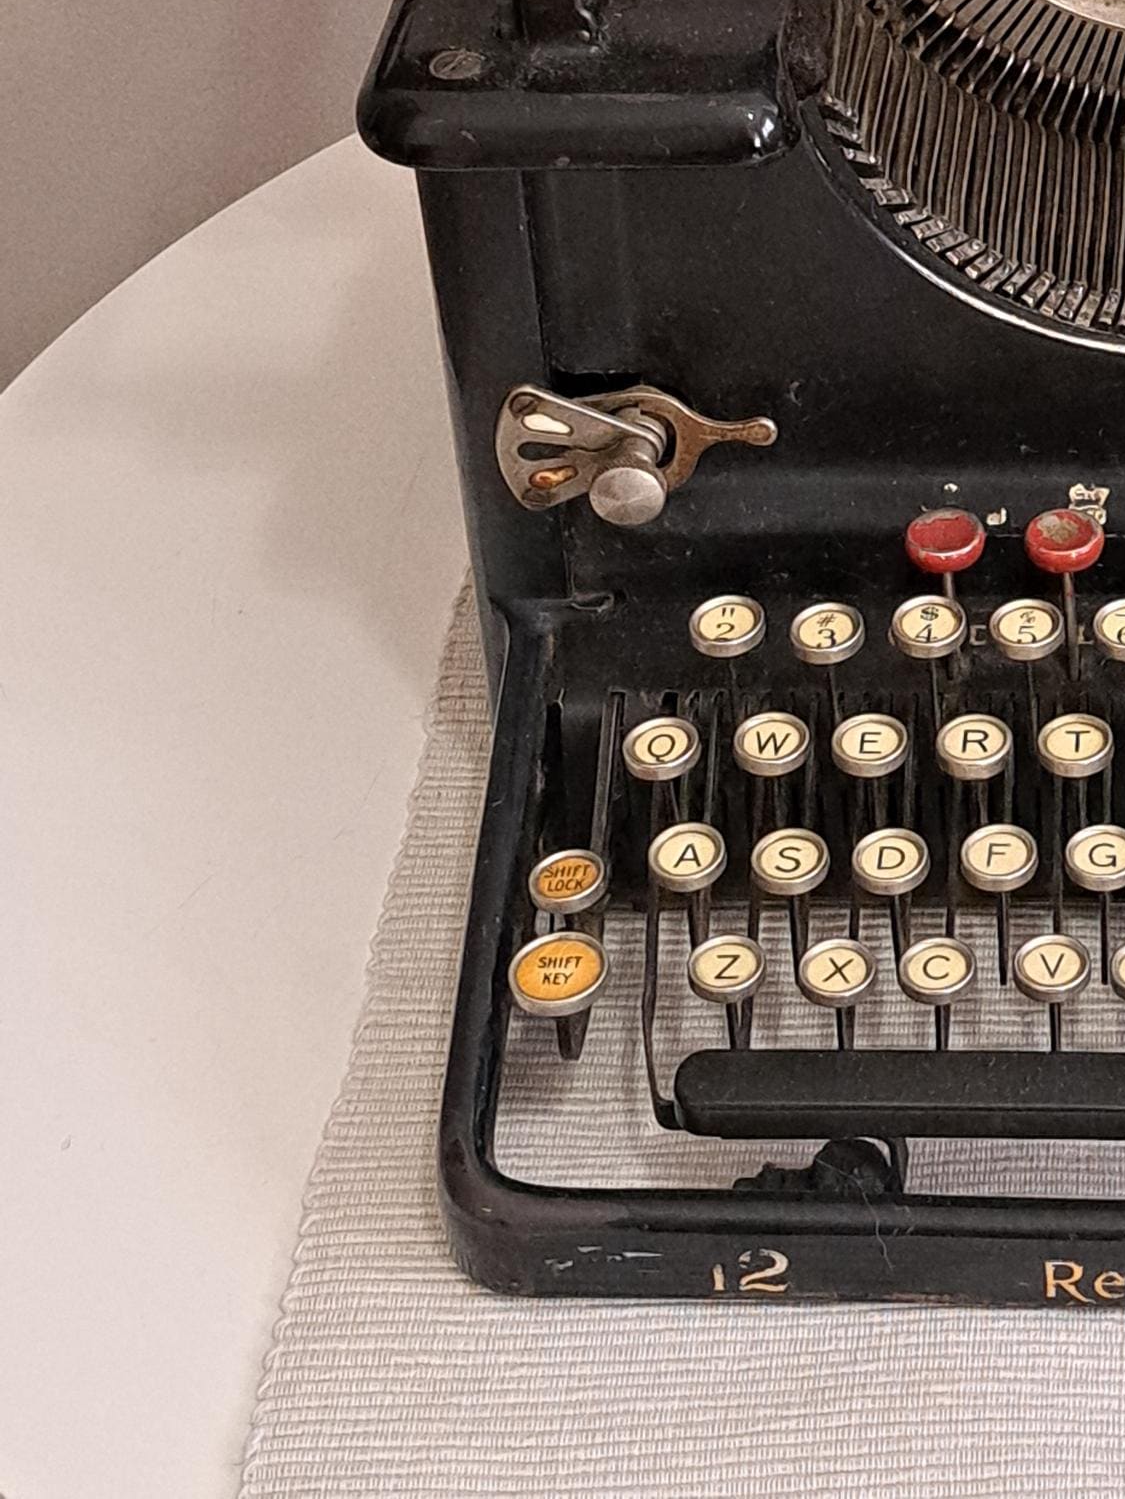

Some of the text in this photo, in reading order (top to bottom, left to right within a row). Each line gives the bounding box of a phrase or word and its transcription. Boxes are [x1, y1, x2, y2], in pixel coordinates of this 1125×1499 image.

[816, 613, 836, 626] #
[919, 606, 939, 621] $
[714, 622, 736, 642] 2
[816, 628, 837, 649] 3
[914, 624, 938, 644] 4
[1016, 625, 1038, 645] 5
[647, 733, 676, 762] Q
[756, 731, 792, 756] W
[858, 731, 883, 754] E
[961, 729, 989, 753] R
[1065, 730, 1091, 753] T
[673, 842, 702, 868] A
[774, 846, 803, 873] S
[876, 846, 906, 870] D
[986, 843, 1012, 867] F
[1088, 842, 1117, 868] G
[544, 863, 591, 879] SHIFT
[547, 878, 585, 893] LOCK
[538, 956, 584, 970] SHIFT
[714, 954, 741, 980] Z
[822, 957, 855, 984] X
[922, 954, 951, 981] C
[1040, 953, 1065, 979] V
[542, 972, 574, 986] KEY
